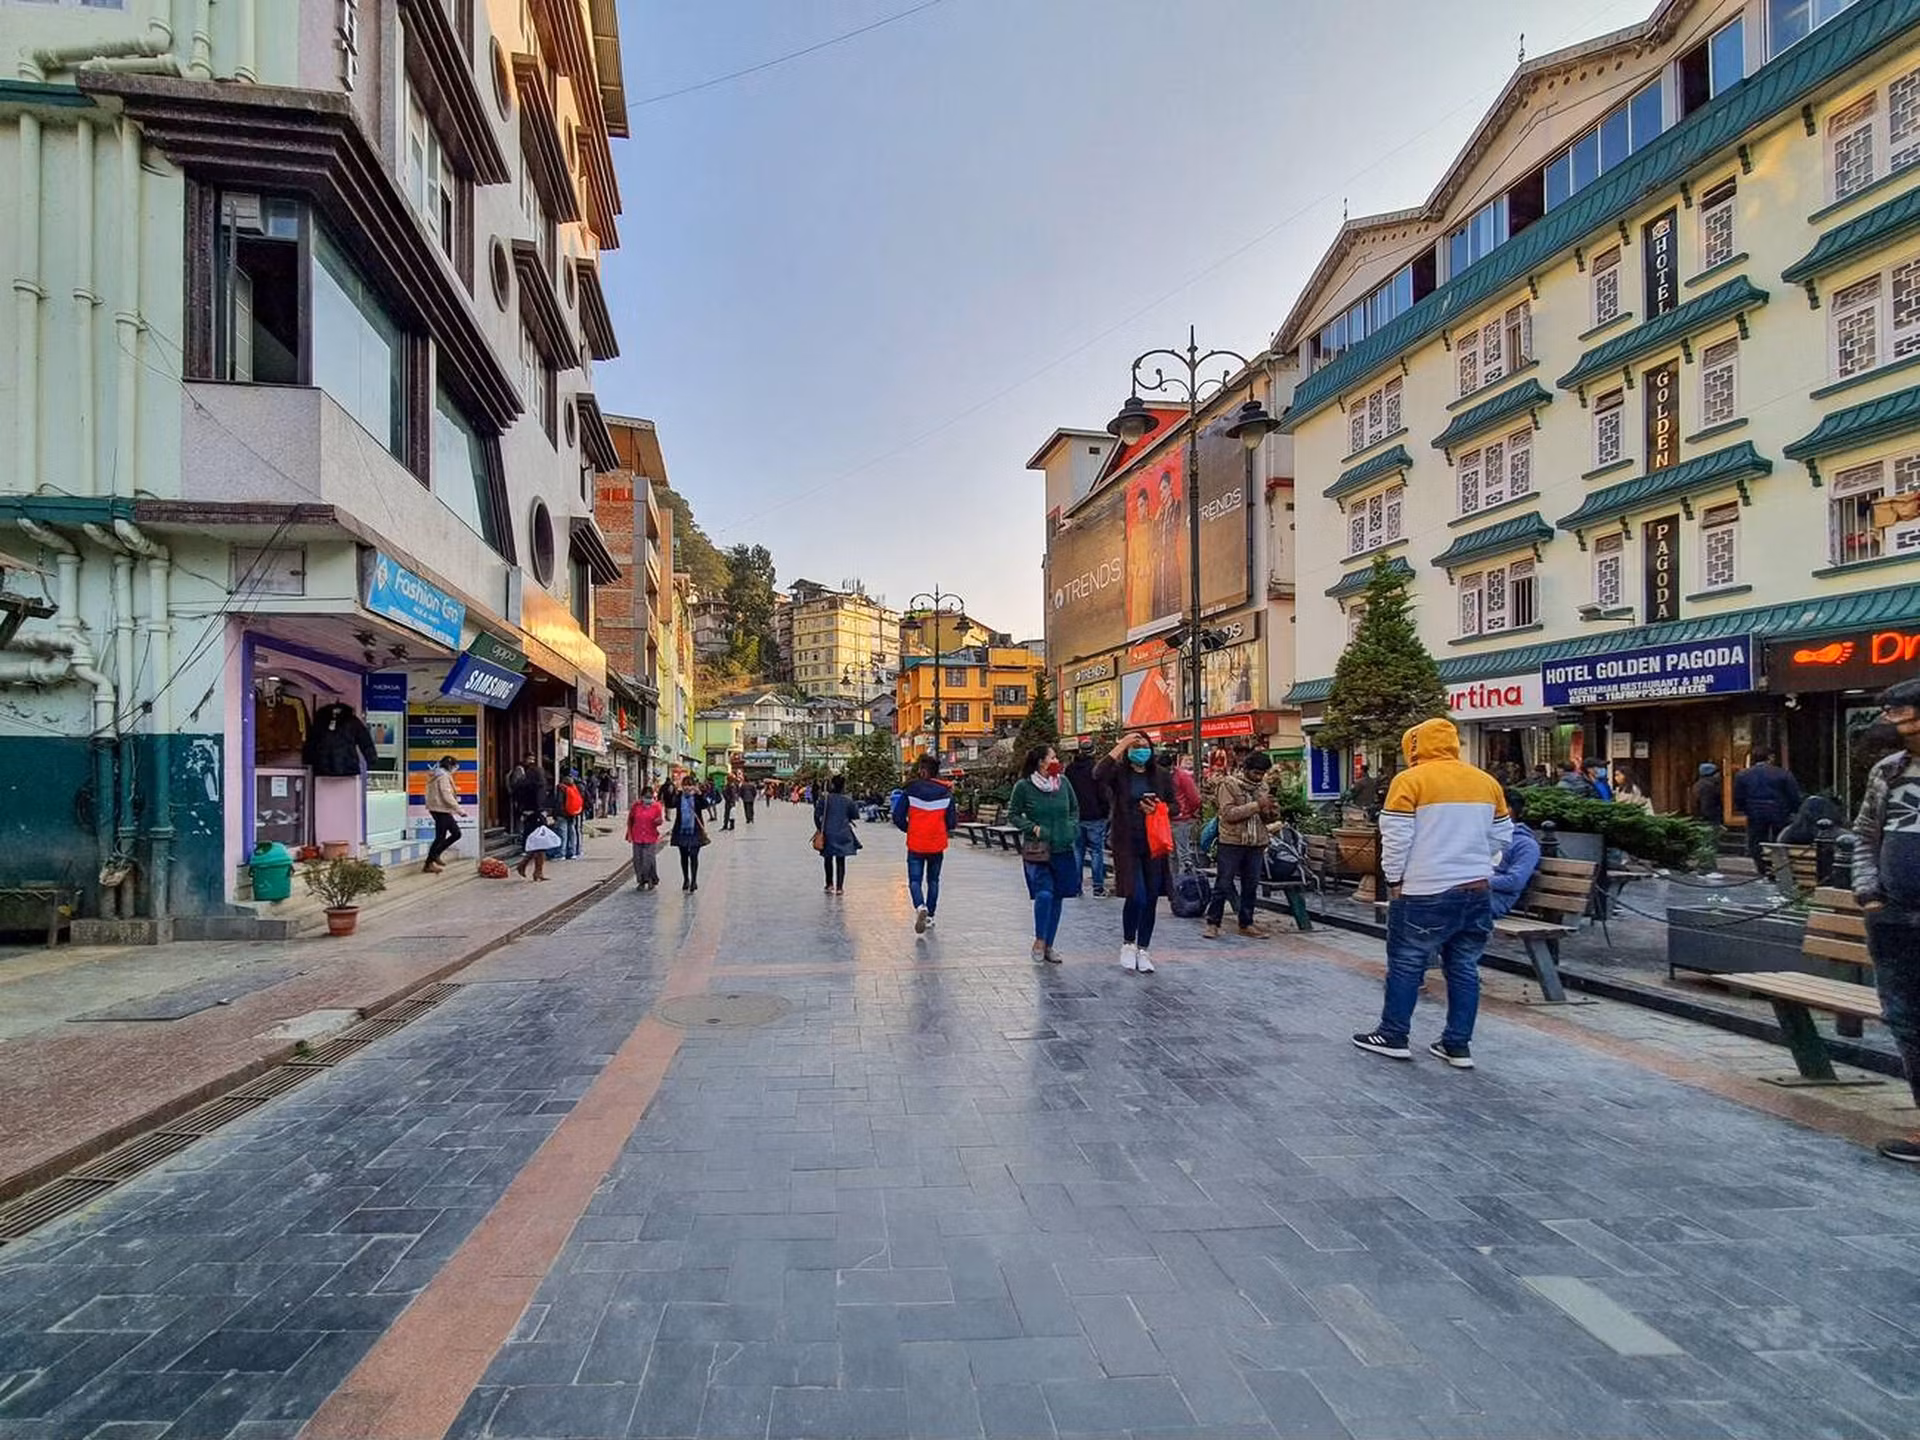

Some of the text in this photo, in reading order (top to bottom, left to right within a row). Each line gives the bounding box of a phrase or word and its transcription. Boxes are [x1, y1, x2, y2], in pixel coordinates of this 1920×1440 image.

[1656, 236, 1669, 314] HOTEL
[1656, 371, 1670, 468] GOLDEN
[1199, 487, 1242, 520] RENDS
[1063, 557, 1122, 604] TRENDS
[1656, 524, 1670, 619] PAGODA
[1546, 645, 1745, 685] HOTEL GOLDEN PAGODA
[1692, 674, 1714, 686] BAR
[464, 669, 514, 700] SAMSUNG
[424, 716, 461, 724] SAMSUNG
[425, 728, 459, 736] NOKIA
